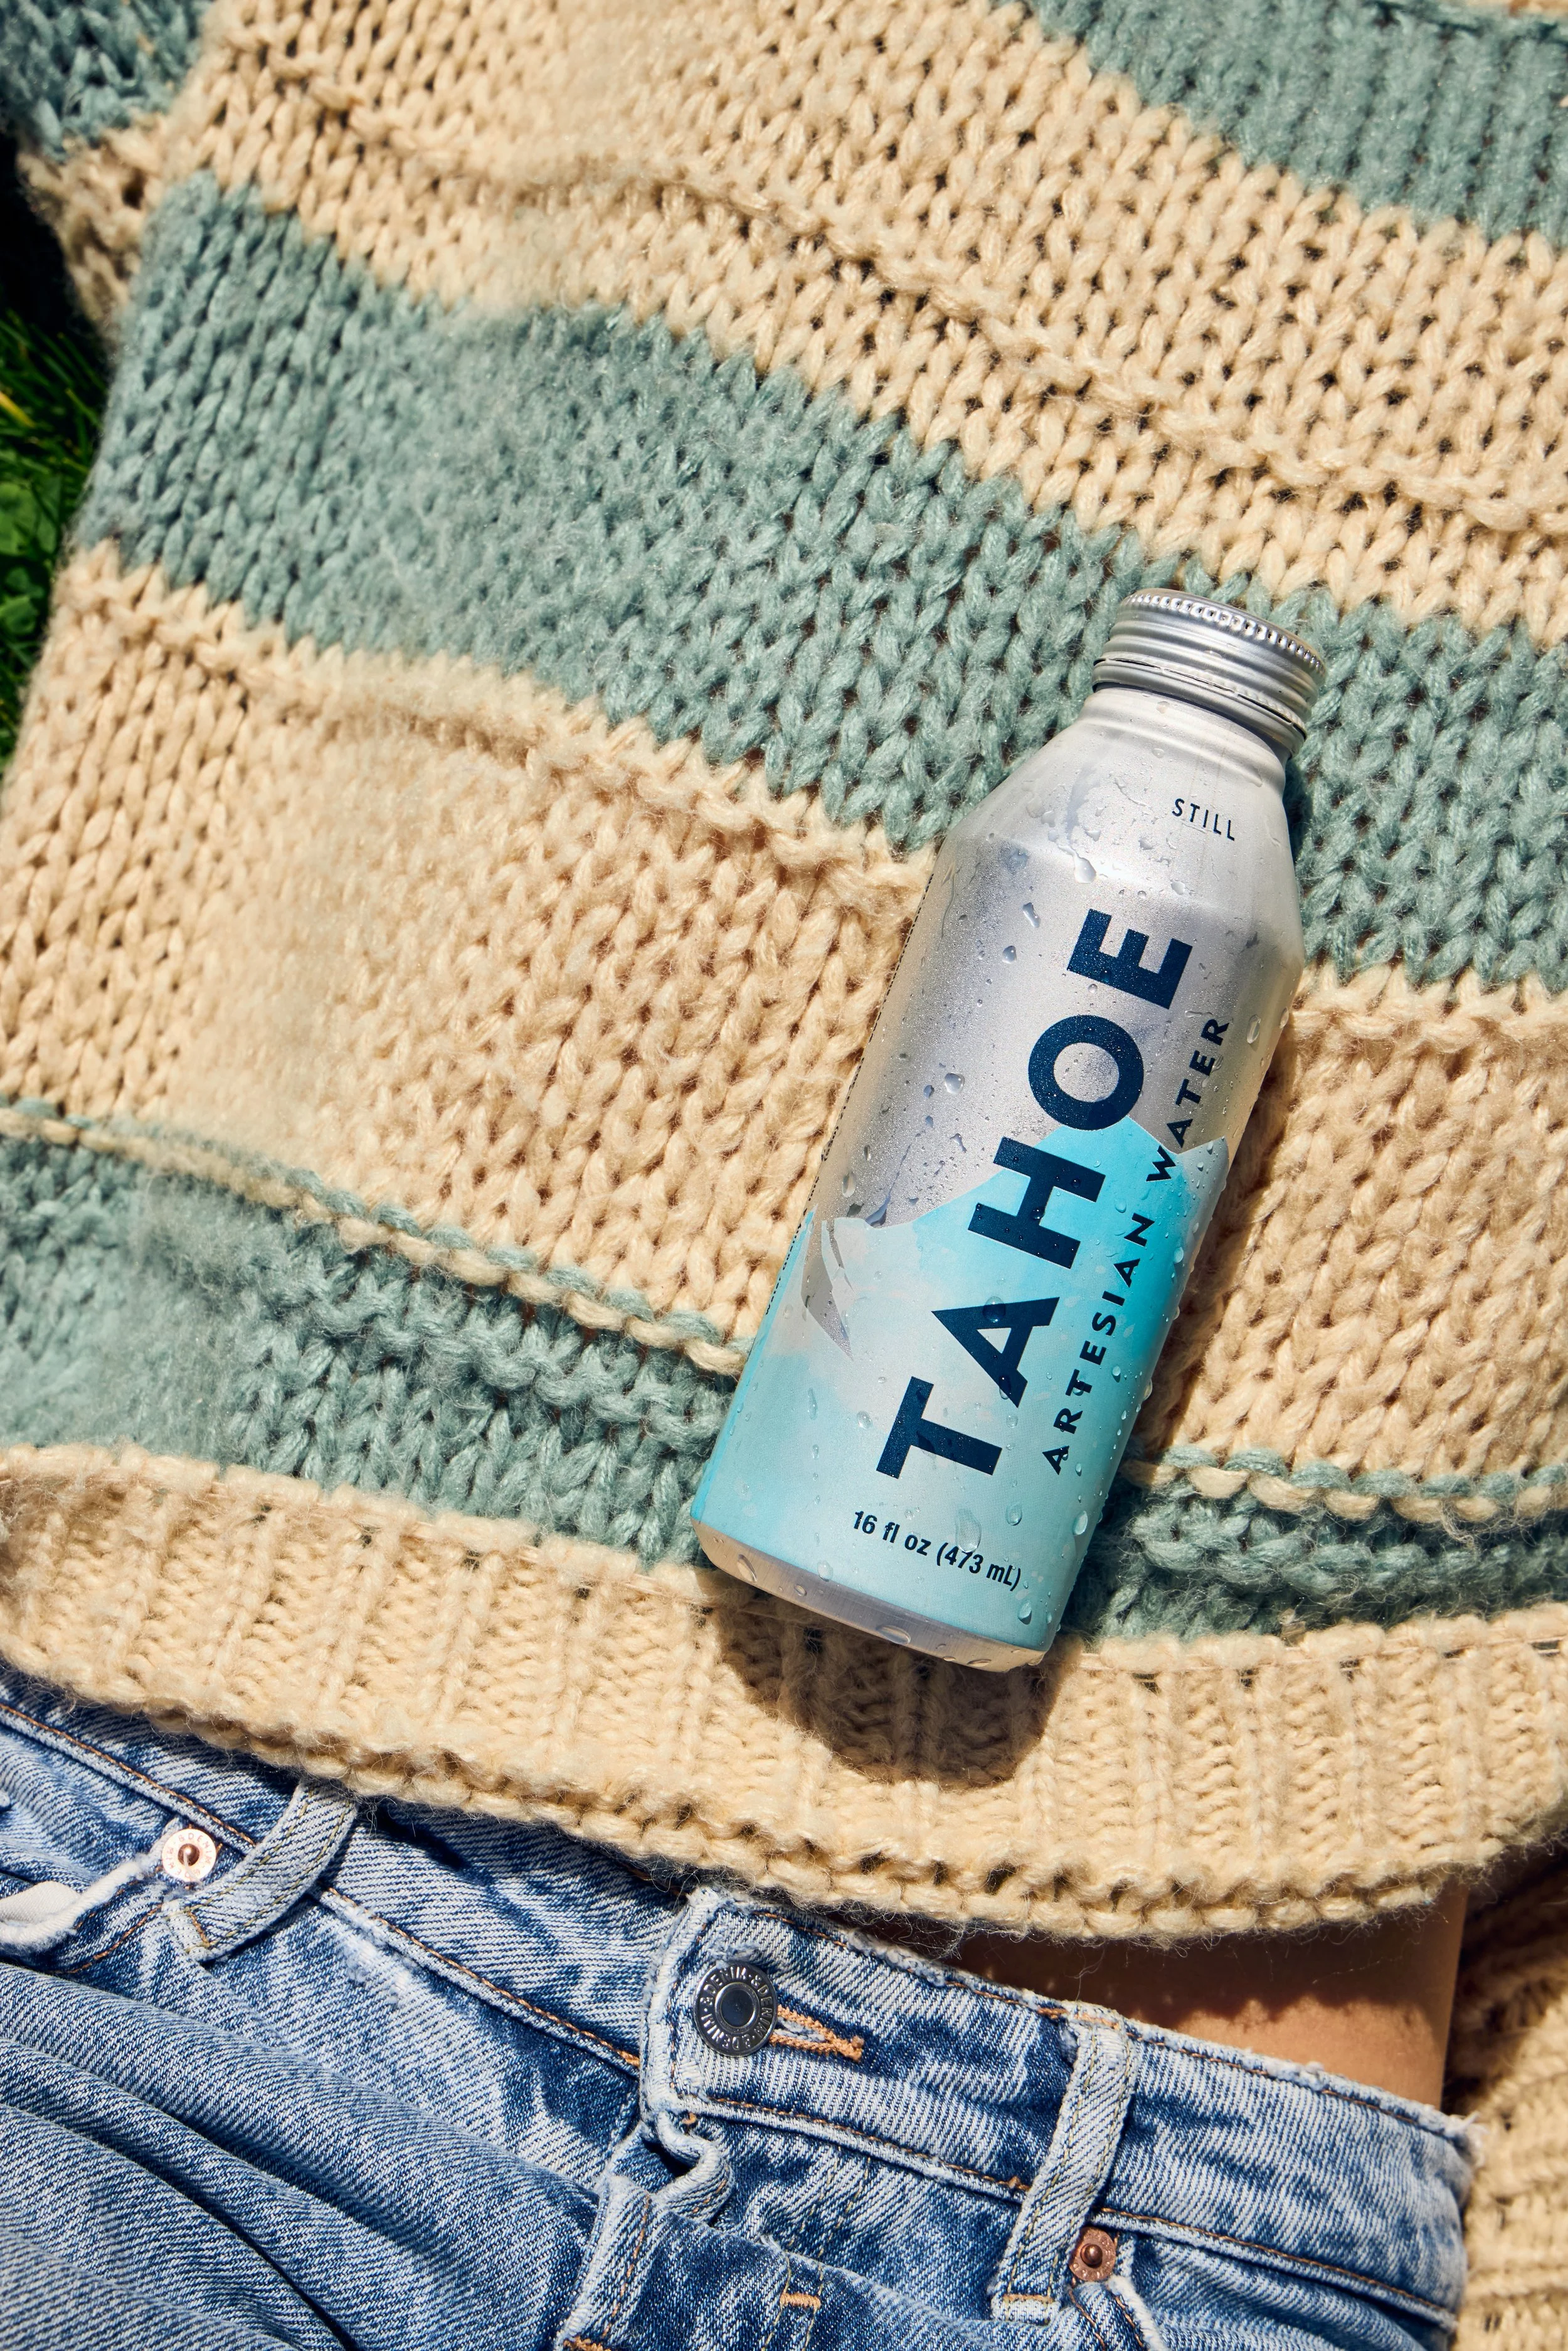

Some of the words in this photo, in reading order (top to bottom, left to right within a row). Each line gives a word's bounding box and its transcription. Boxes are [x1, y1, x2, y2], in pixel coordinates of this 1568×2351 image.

[1172, 798, 1235, 841] STILL
[876, 908, 1193, 1479] TAHOE
[1042, 1211, 1155, 1475] ARTESIAN
[1145, 1018, 1230, 1182] WATER
[854, 1510, 877, 1534] 16
[882, 1522, 901, 1544] fl
[904, 1534, 931, 1556] oz
[936, 1542, 984, 1574] (473
[985, 1563, 1021, 1592] mL)
